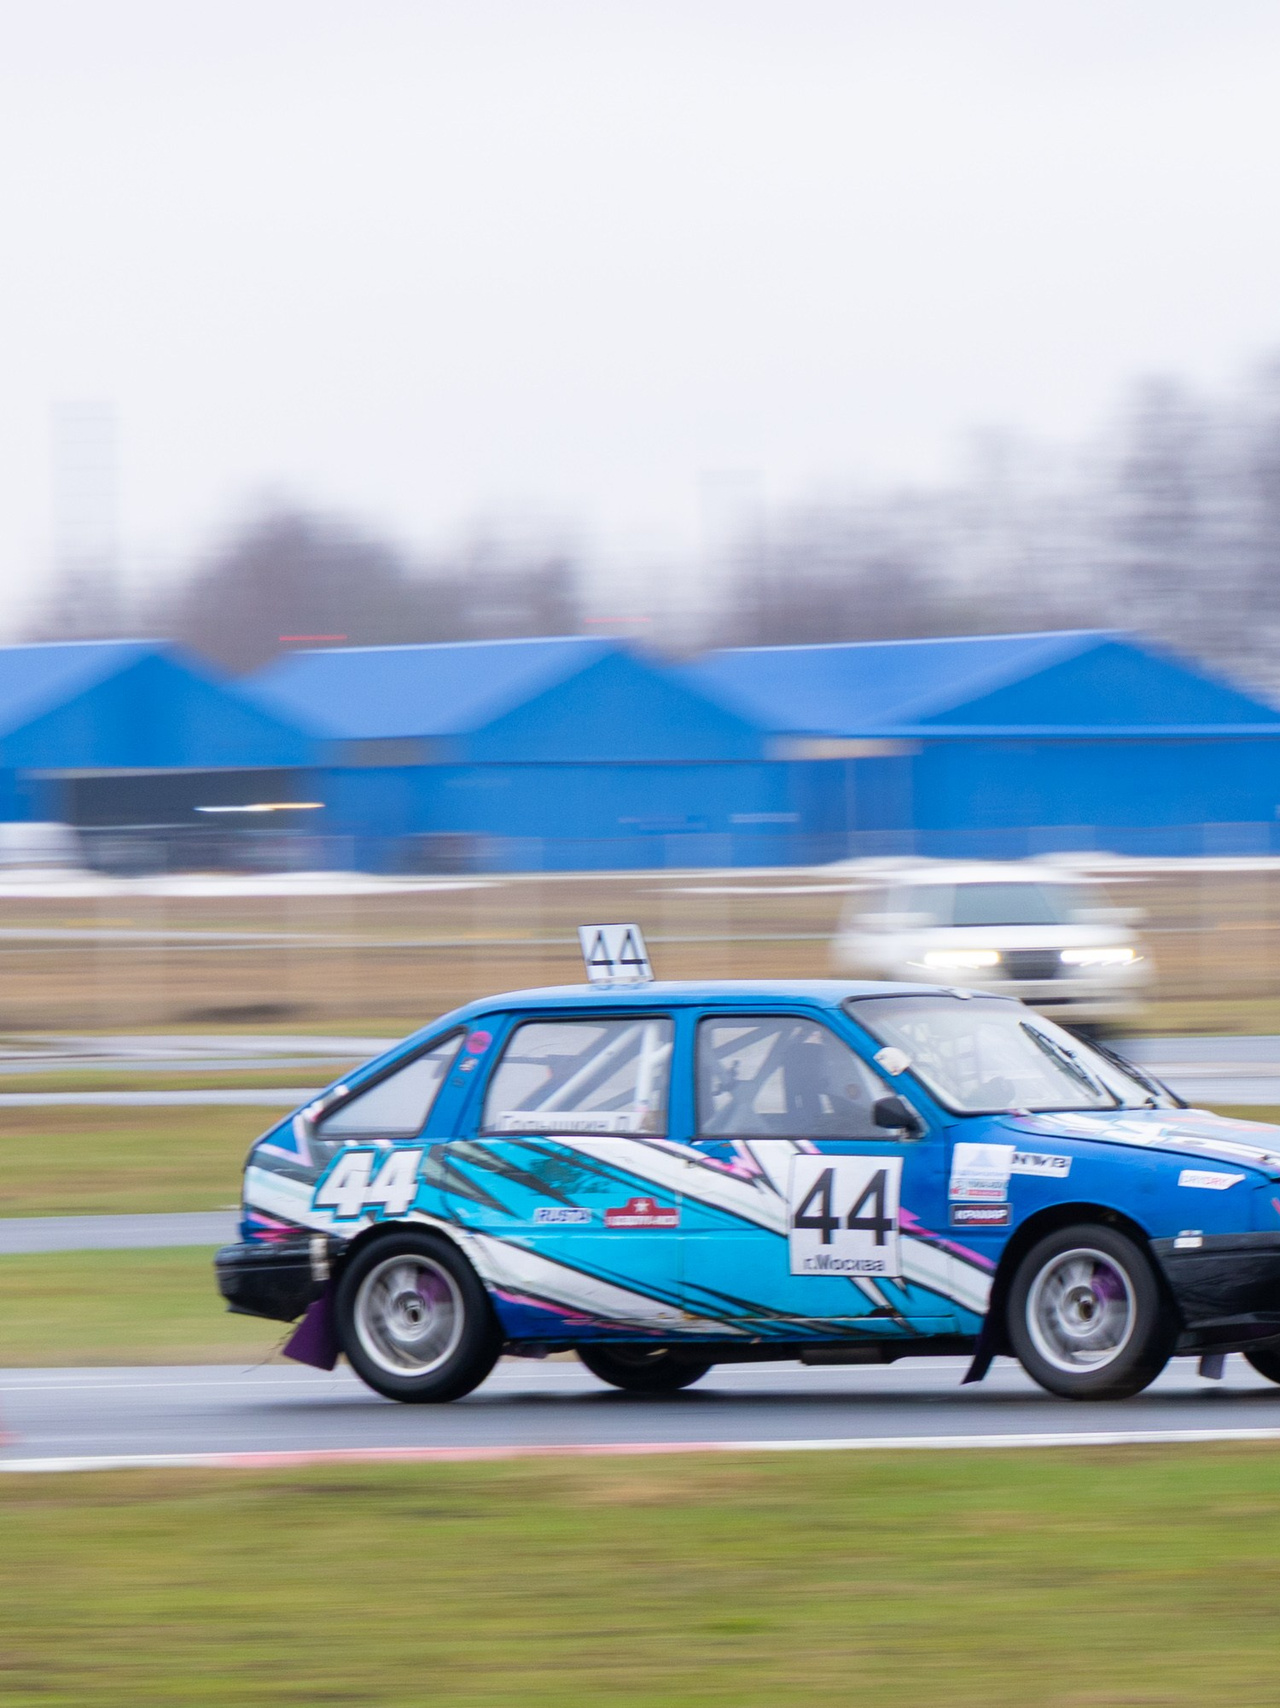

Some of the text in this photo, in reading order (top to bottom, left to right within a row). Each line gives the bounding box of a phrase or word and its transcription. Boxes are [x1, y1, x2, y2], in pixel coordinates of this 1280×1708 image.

[587, 929, 648, 976] 44
[1011, 1152, 1067, 1170] NWB
[314, 1148, 425, 1220] 44
[537, 1209, 589, 1222] RUSTA
[792, 1167, 897, 1246] 44
[804, 1254, 885, 1272] г.Москва
